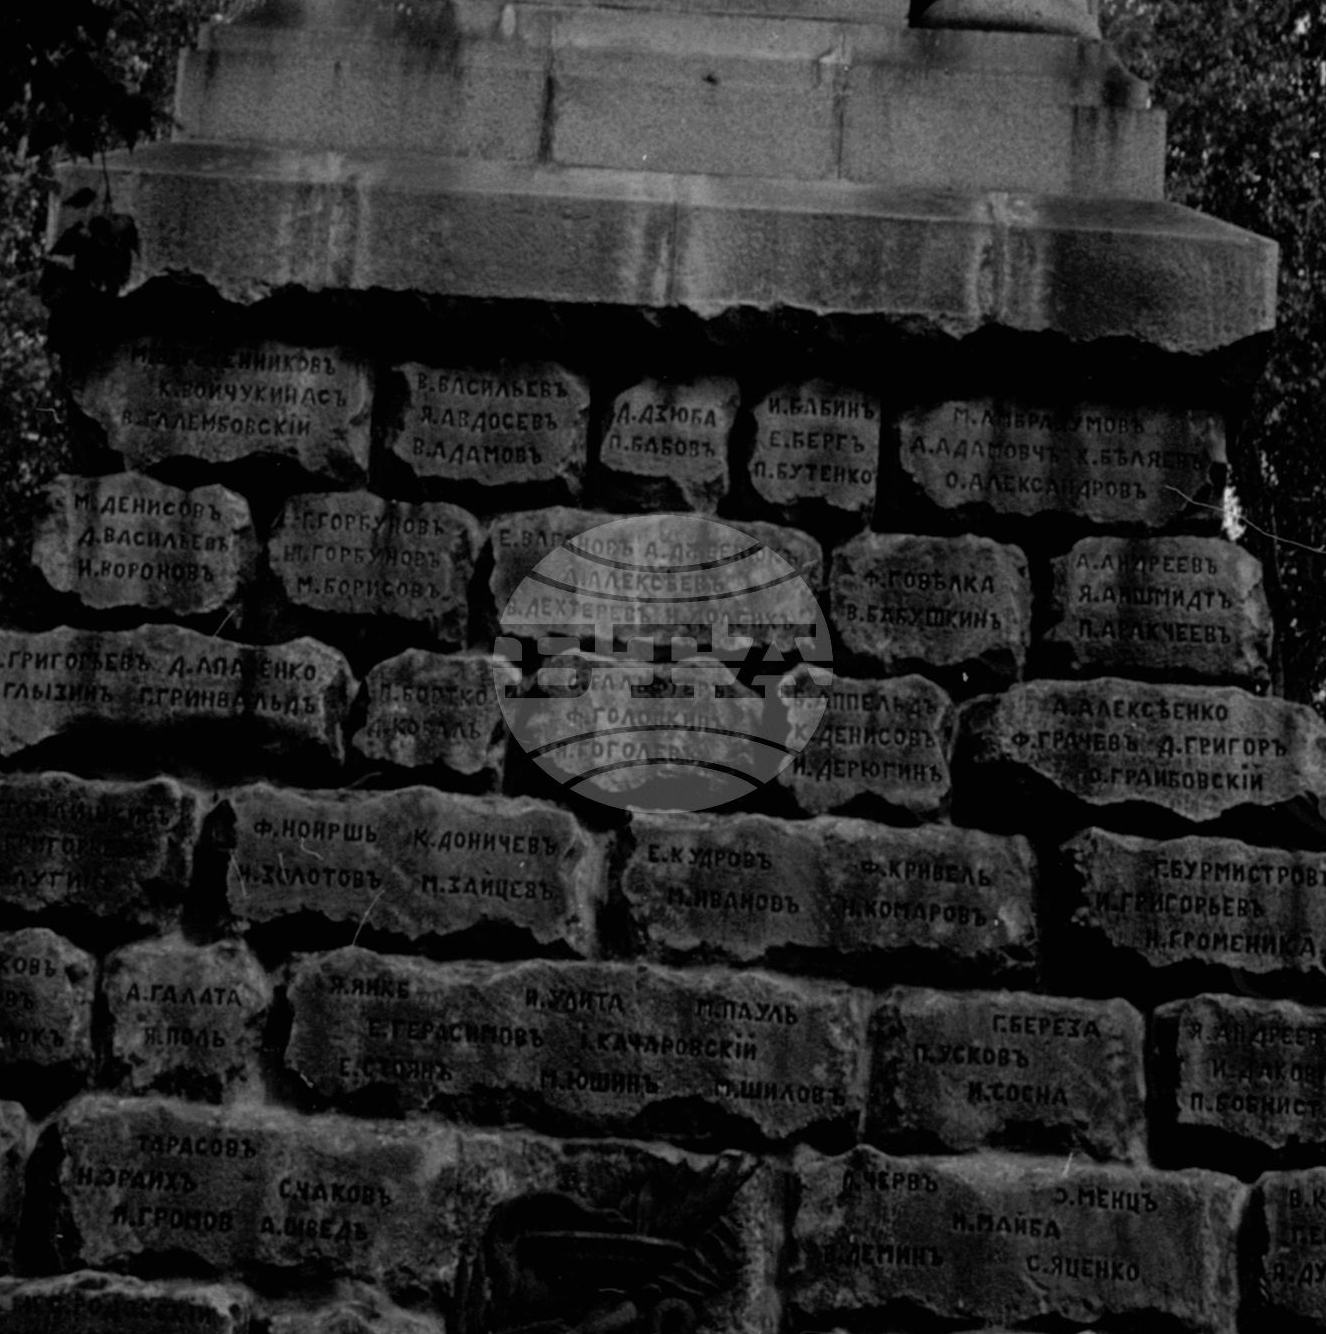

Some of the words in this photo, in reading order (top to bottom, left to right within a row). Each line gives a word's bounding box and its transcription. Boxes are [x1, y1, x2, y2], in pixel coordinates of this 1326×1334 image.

[754, 462, 872, 484] П.БУТЕНКО
[75, 494, 221, 521] М.ДЕНИСОВЪ
[127, 984, 241, 1007] А.ГАЛАТА
